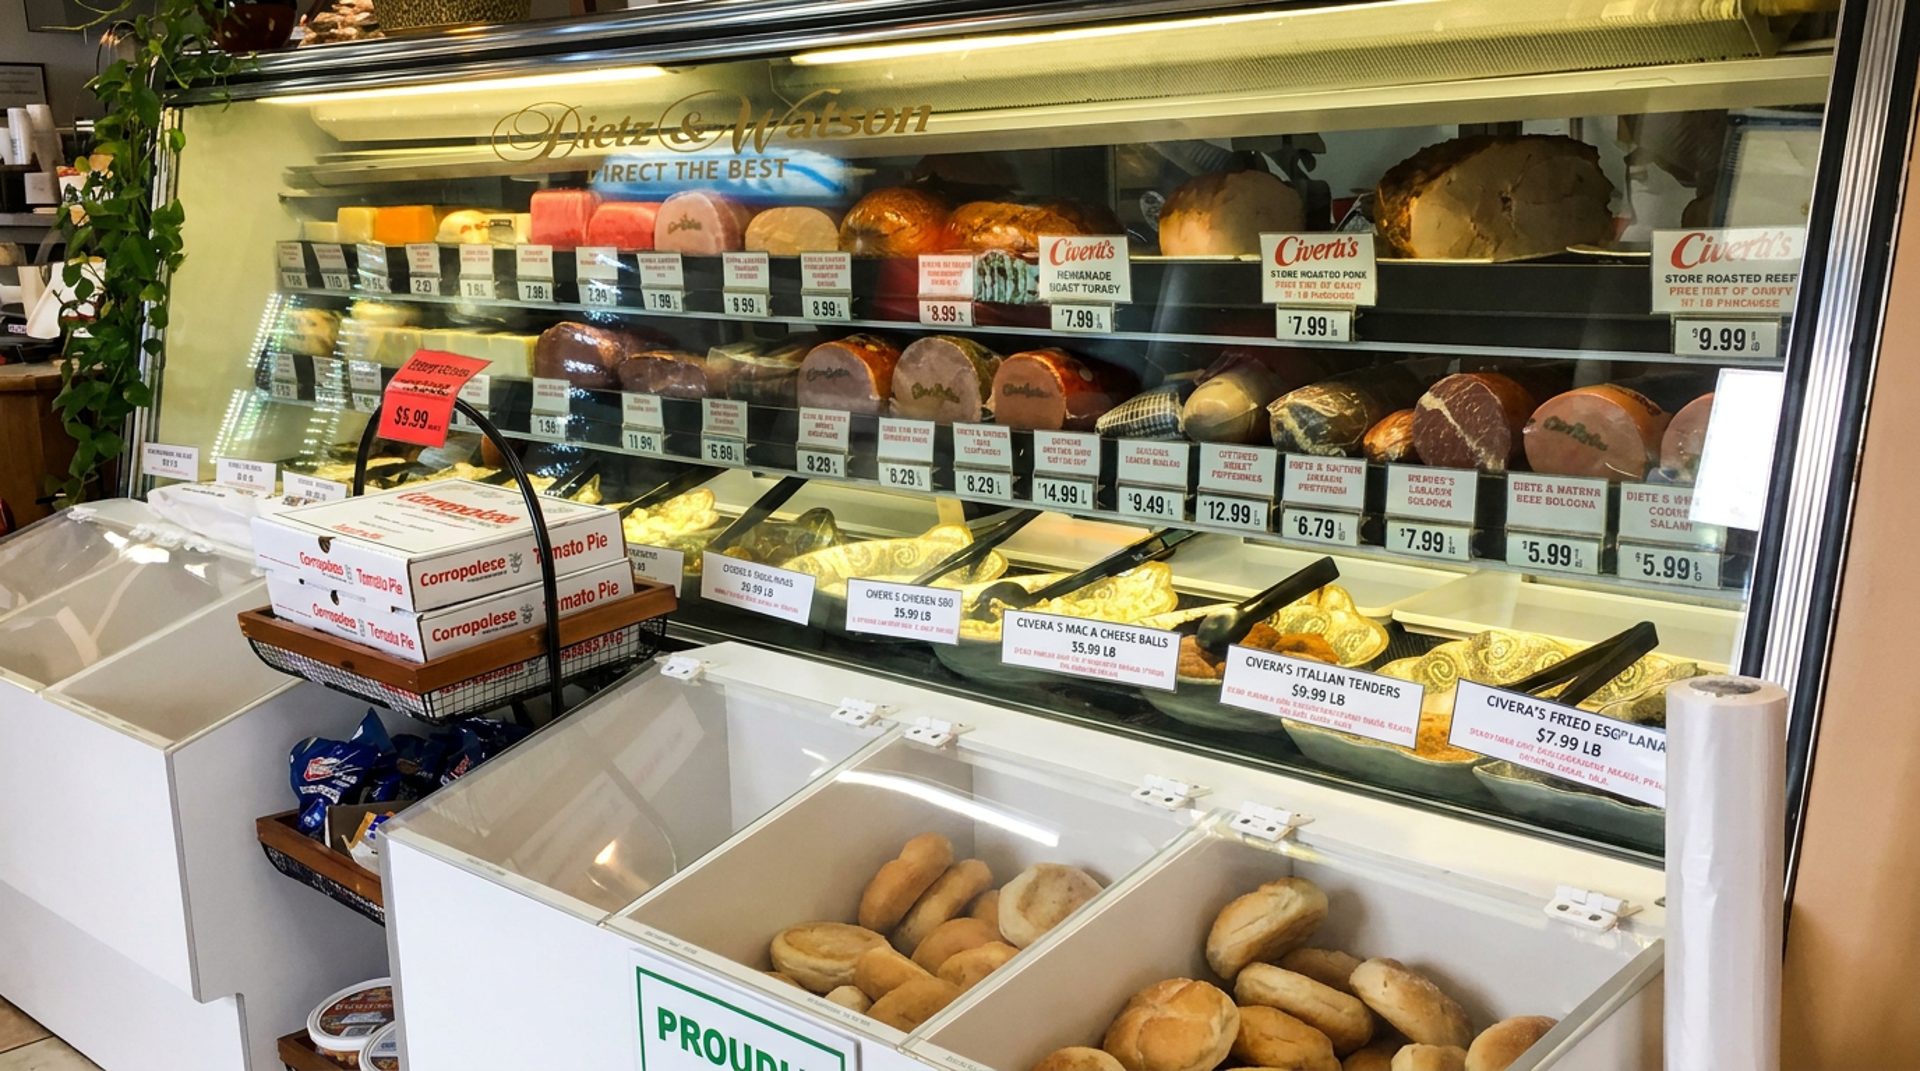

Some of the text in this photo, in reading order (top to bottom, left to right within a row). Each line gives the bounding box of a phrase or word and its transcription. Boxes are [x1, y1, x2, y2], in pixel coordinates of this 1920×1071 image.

[492, 101, 654, 163] Dietz
[733, 88, 933, 154] Watson
[675, 160, 719, 180] THE
[728, 158, 789, 179] BEST
[1665, 274, 1703, 284] STORE
[1706, 273, 1762, 283] ROASTED
[587, 531, 608, 551] Pie
[420, 556, 506, 587] Corropolese
[598, 579, 619, 600] Pie
[432, 607, 517, 643] Corropolese
[1016, 616, 1054, 632] CIVERA
[1066, 624, 1088, 637] MAC
[1100, 628, 1137, 644] CHEESE
[1139, 633, 1169, 649] BALLS
[1296, 666, 1345, 687] ITALIAN
[1348, 677, 1401, 700] TENDERS
[1329, 692, 1346, 706] LB
[1486, 694, 1546, 721] CIVERA'S
[1549, 711, 1591, 732] FRIED
[1536, 727, 1602, 758] $7.99 LB
